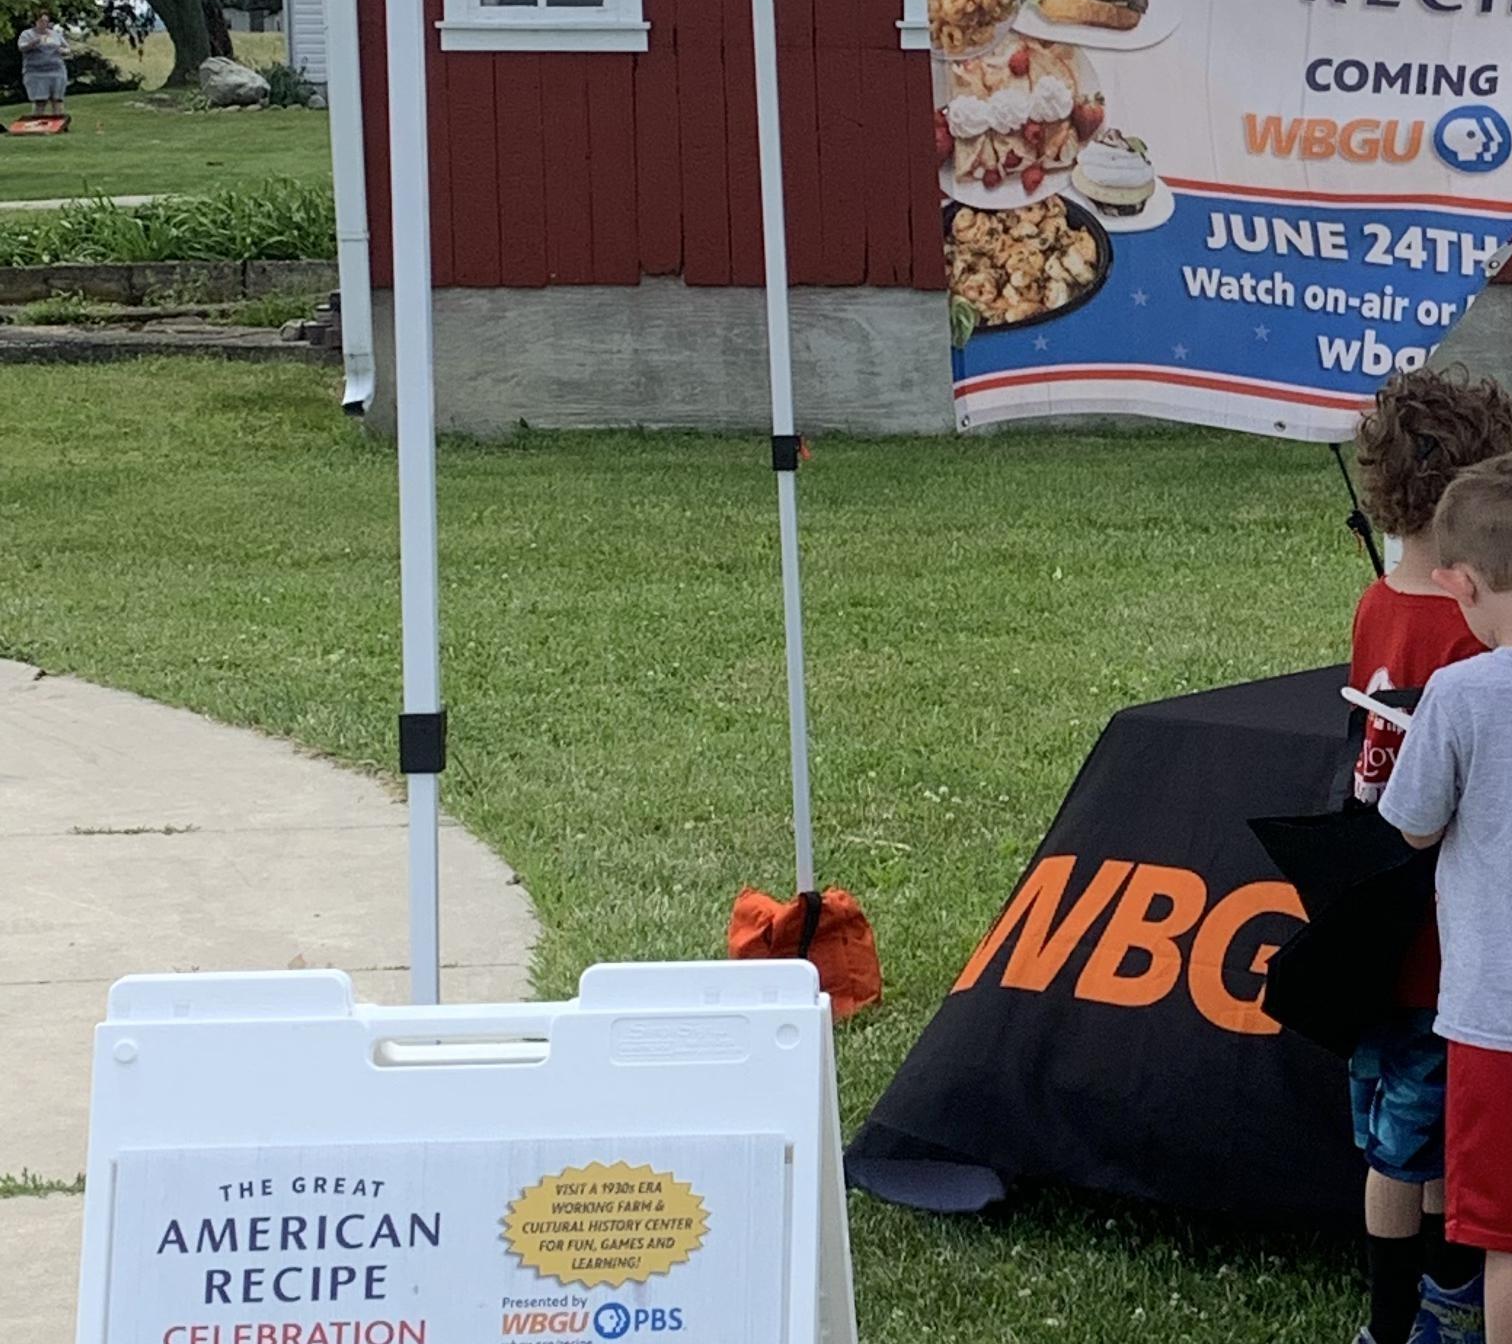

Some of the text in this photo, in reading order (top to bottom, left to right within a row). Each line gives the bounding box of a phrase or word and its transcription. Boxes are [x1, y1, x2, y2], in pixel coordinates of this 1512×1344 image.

[1305, 58, 1499, 96] COMING
[1243, 113, 1425, 164] WBGU
[1206, 212, 1349, 260] JUNE
[1182, 265, 1457, 327] Watch on-air or
[950, 854, 1310, 1035] WBG
[219, 1177, 385, 1202] THE GREAT
[555, 1183, 586, 1196] VISIT
[589, 1184, 598, 1195] A
[638, 1182, 663, 1194] ERA
[551, 1201, 614, 1214] WORKING
[616, 1200, 652, 1213] FARM
[156, 1212, 442, 1254] AMERICAN
[522, 1218, 694, 1234] CULTURAL HISTORY CENTER
[539, 1239, 564, 1252] FOR
[600, 1238, 645, 1250] GAMES
[647, 1237, 676, 1249] AND
[204, 1265, 388, 1304] RECIPE
[502, 1296, 588, 1309] Presented by
[502, 1307, 684, 1335] WBGU PBS
